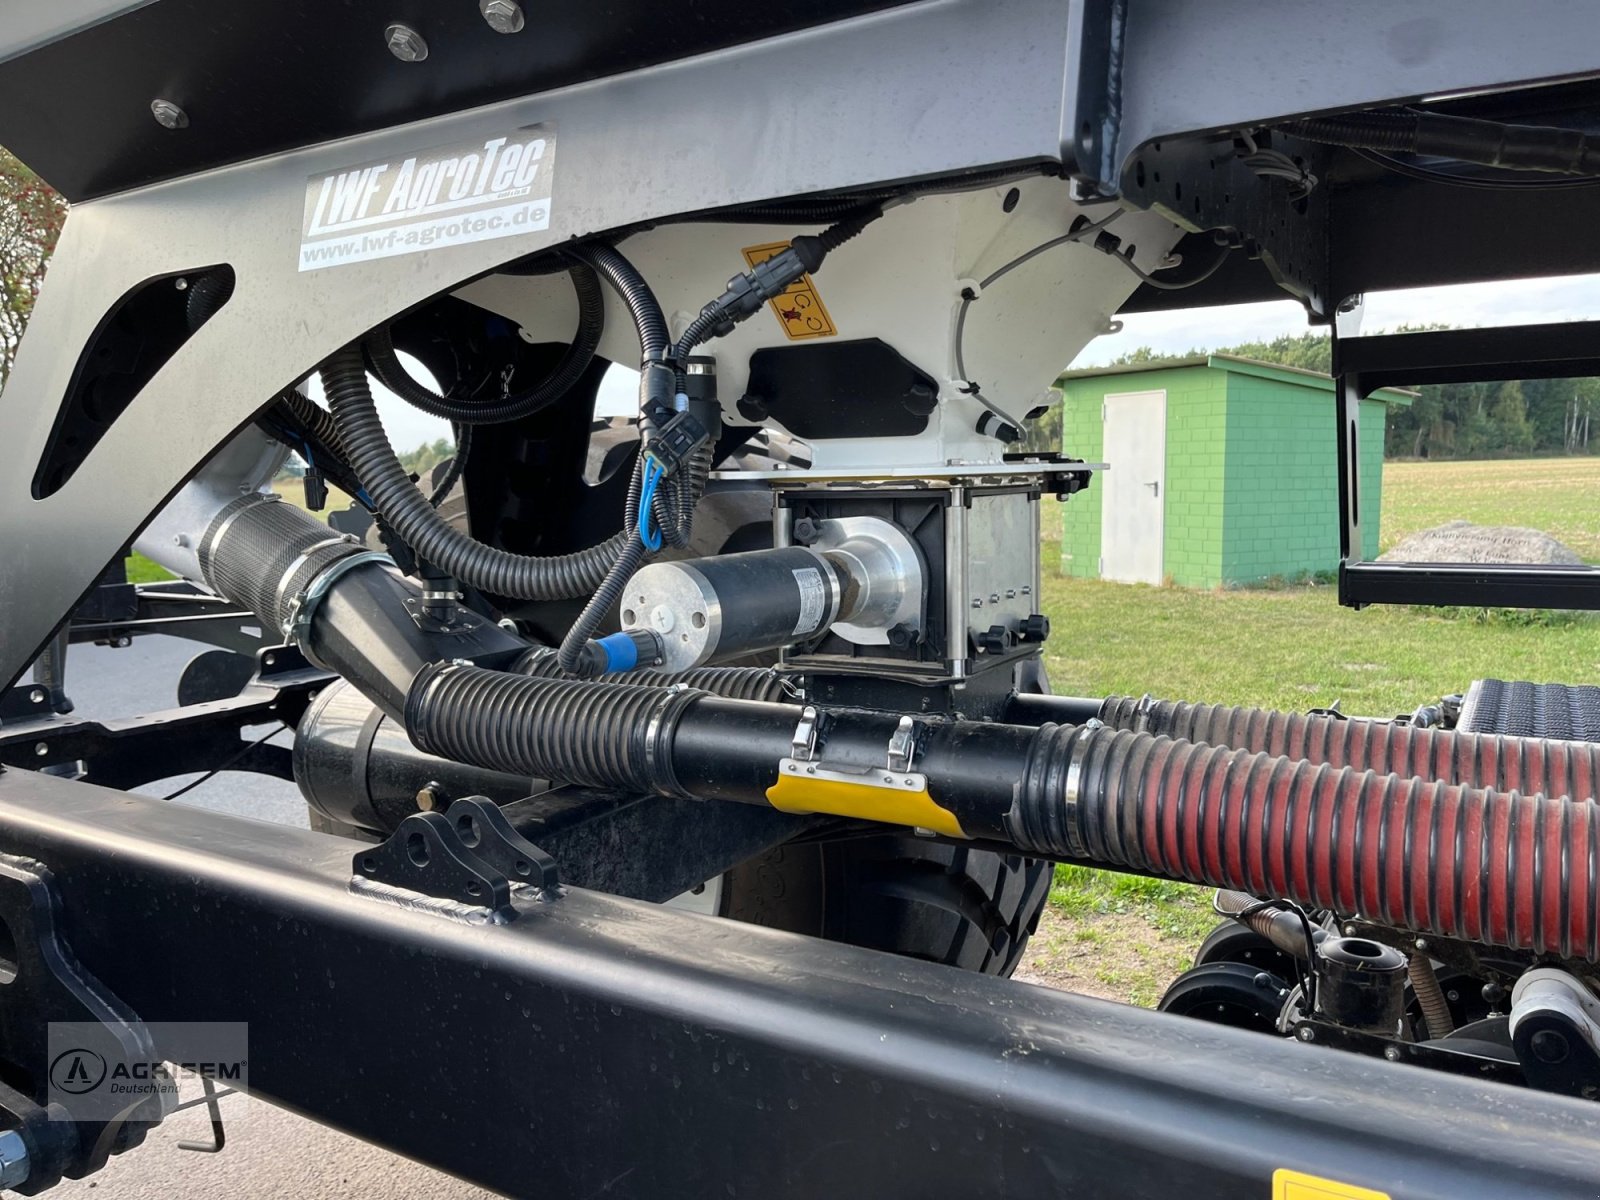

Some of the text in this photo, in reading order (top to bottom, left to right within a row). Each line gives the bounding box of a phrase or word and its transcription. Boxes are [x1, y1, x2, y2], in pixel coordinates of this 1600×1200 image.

[308, 137, 546, 236] LWF AgroTec
[303, 206, 546, 263] www.lwf-agrotec.de
